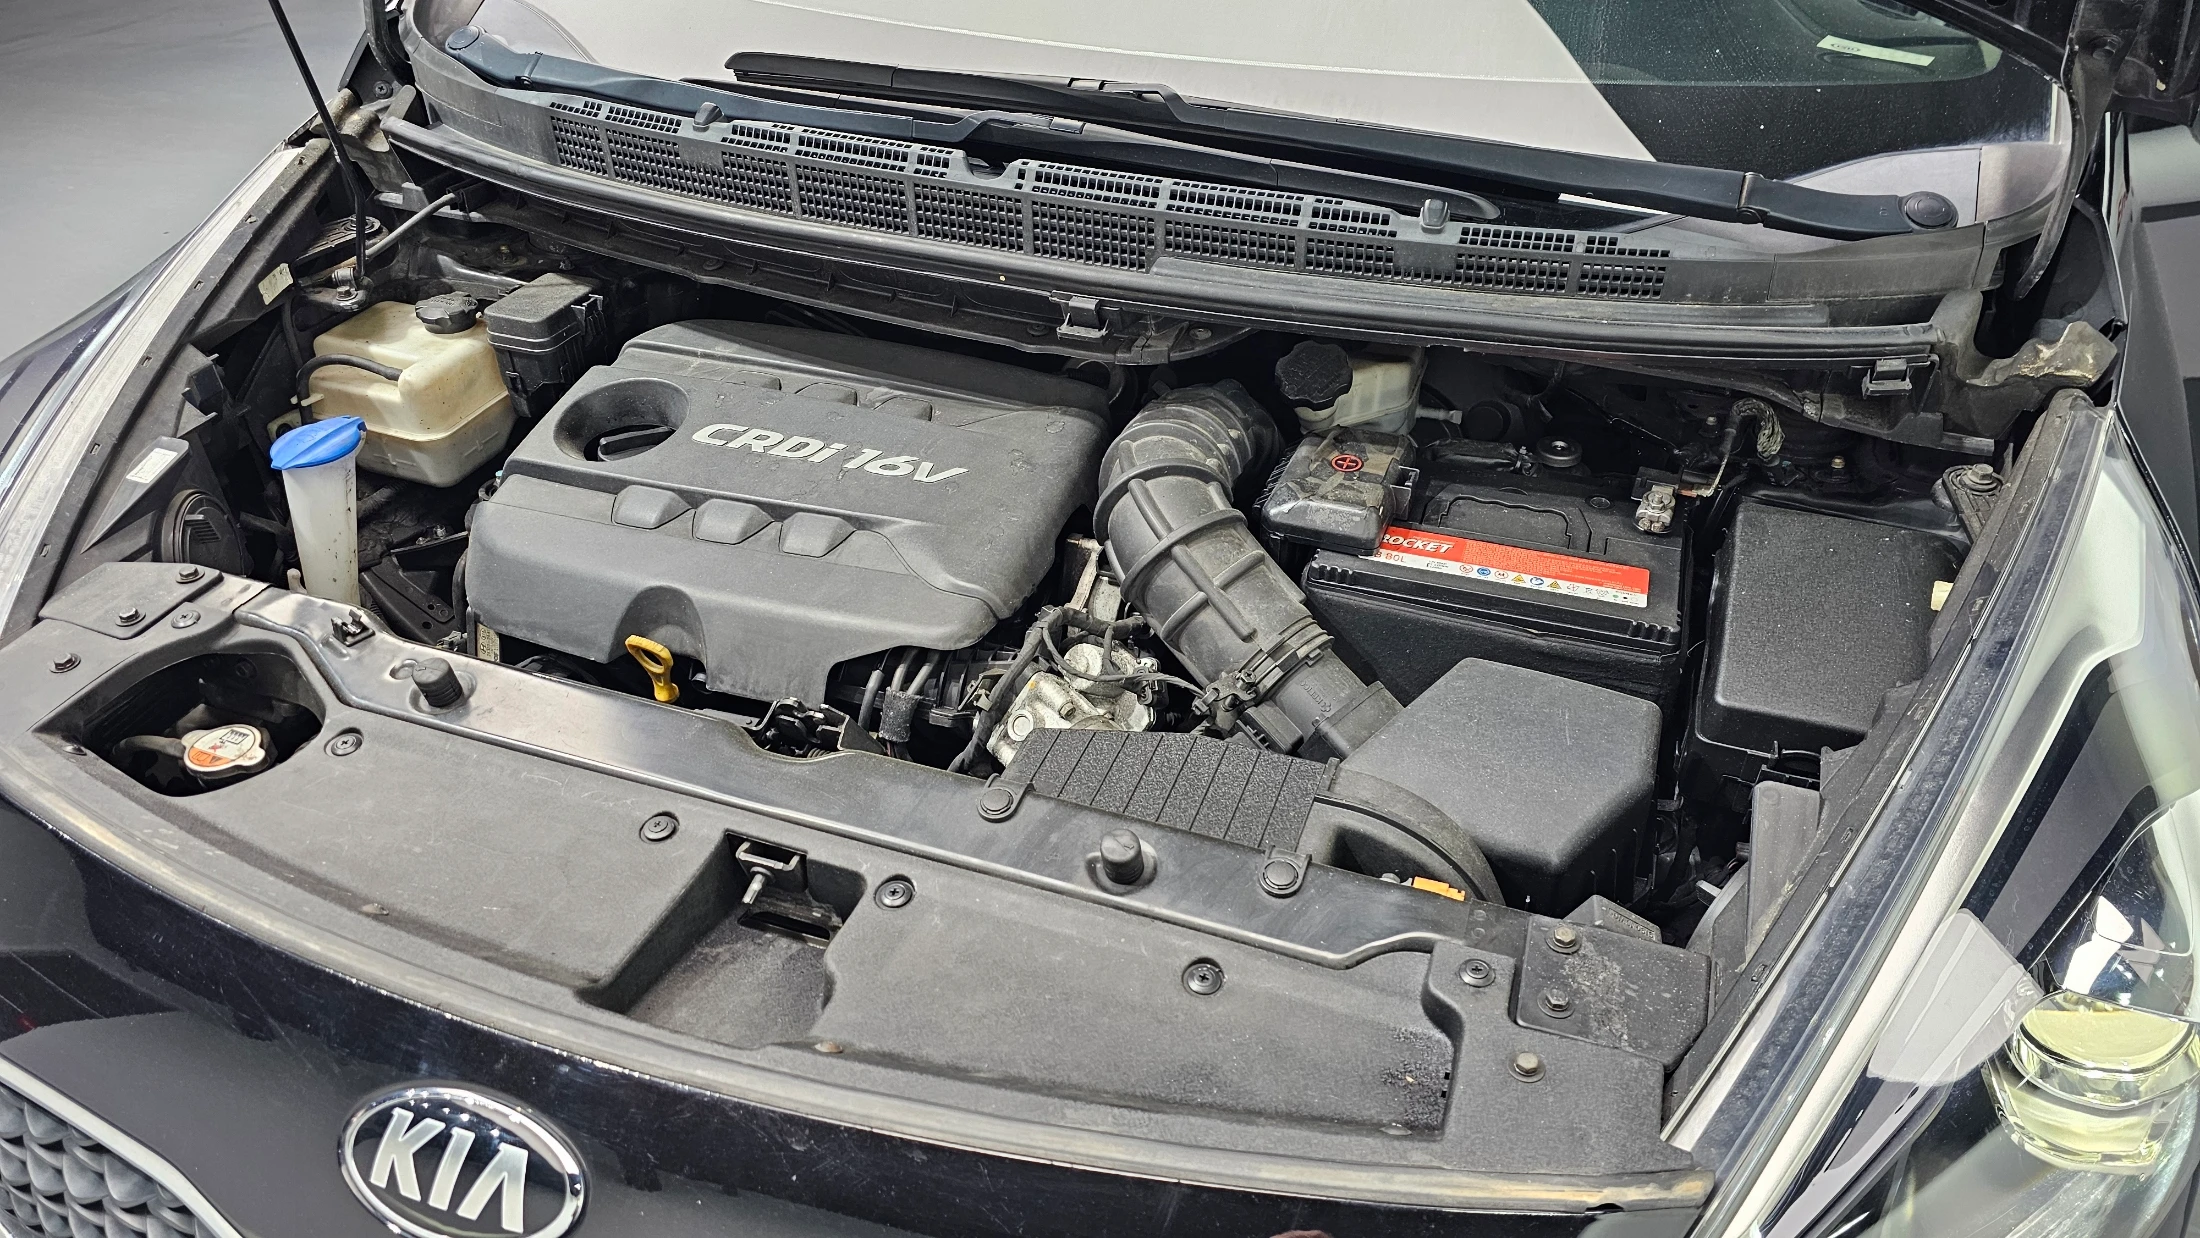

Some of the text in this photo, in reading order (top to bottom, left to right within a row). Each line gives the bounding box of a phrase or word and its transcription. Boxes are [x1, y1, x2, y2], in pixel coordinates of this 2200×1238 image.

[691, 423, 969, 484] CRDi 16V
[369, 1106, 529, 1234] KIA
